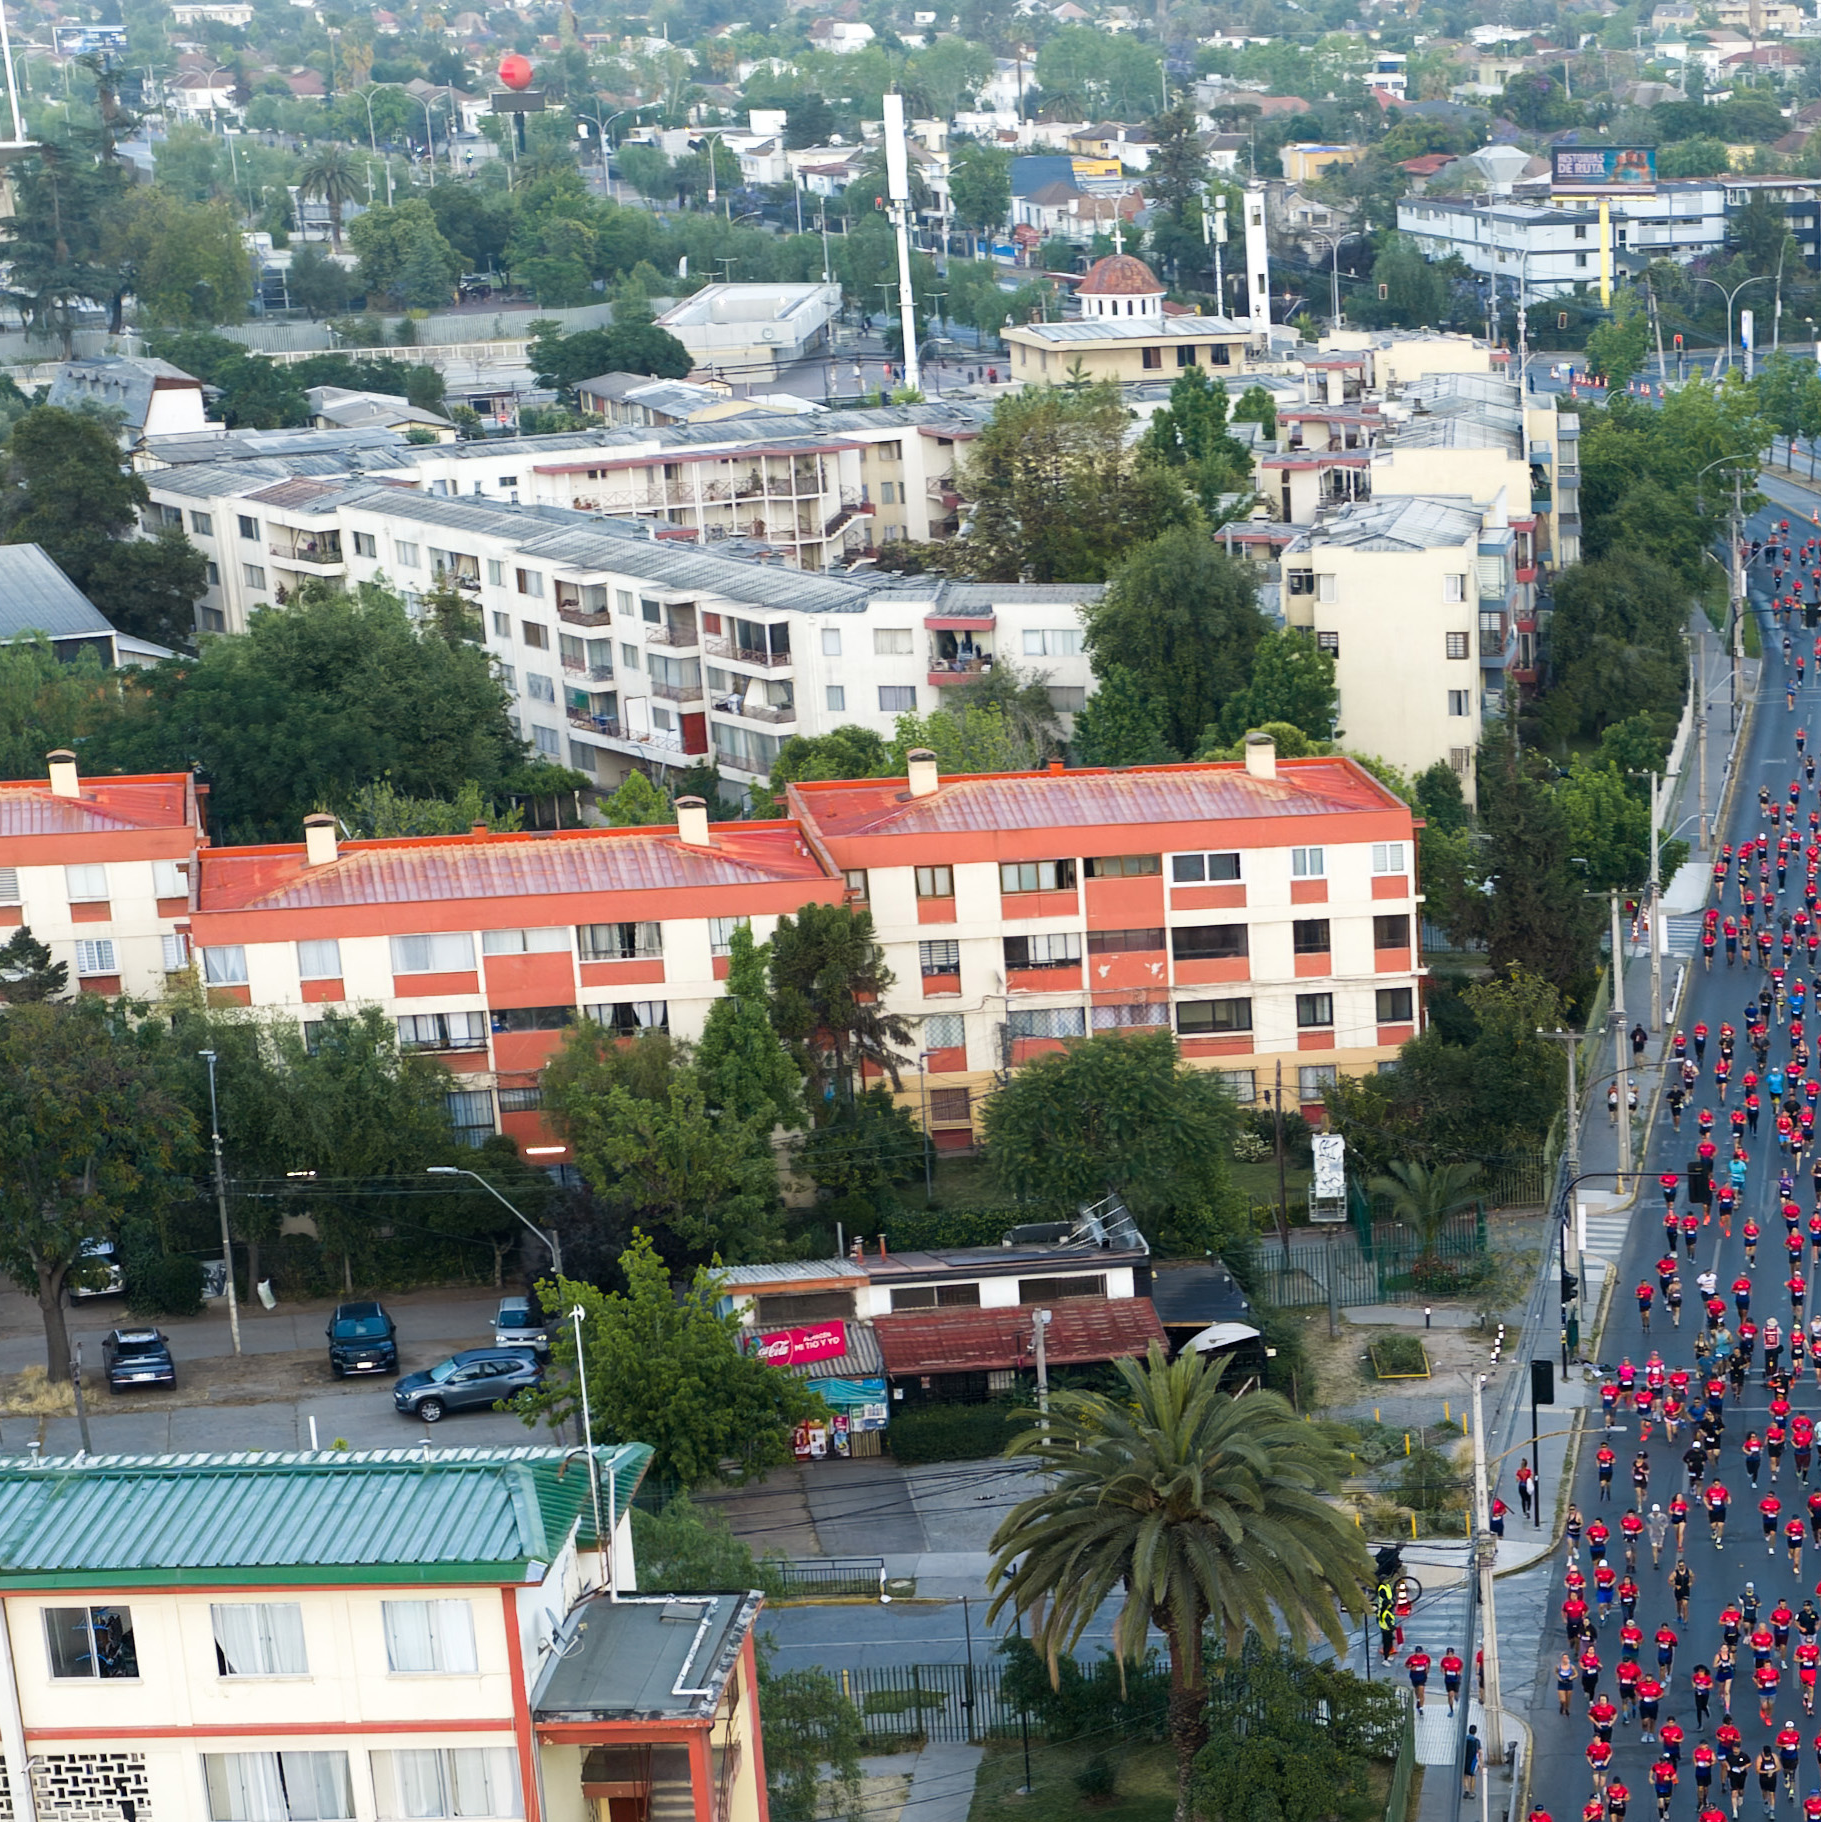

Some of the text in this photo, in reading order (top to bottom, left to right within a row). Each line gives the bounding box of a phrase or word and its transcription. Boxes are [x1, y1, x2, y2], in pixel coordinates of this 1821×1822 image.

[1557, 153, 1605, 164] HISTORIAS
[1557, 163, 1605, 174] DE RUTA
